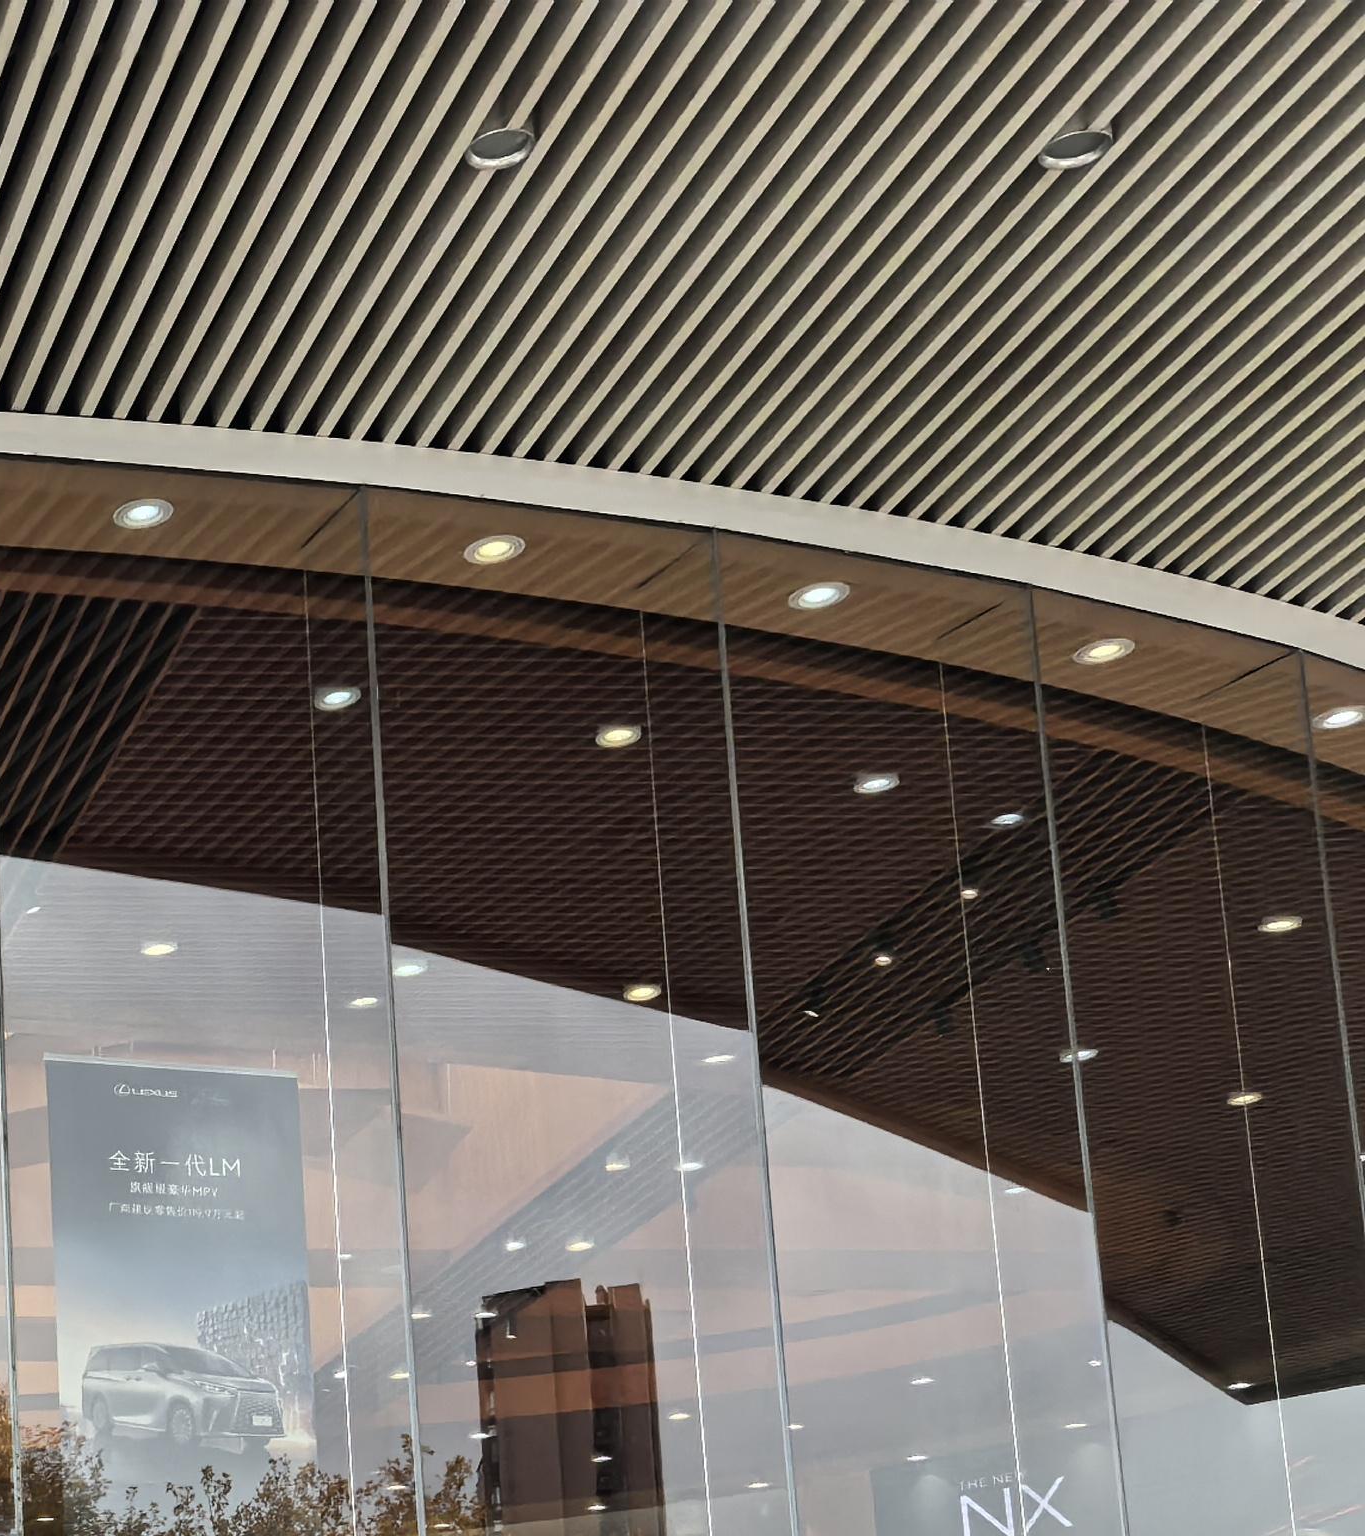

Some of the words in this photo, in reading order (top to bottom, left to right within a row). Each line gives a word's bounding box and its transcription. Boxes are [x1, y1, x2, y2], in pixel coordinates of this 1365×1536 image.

[131, 1088, 178, 1098] LEXUS
[109, 1150, 242, 1178] 全新一代LM
